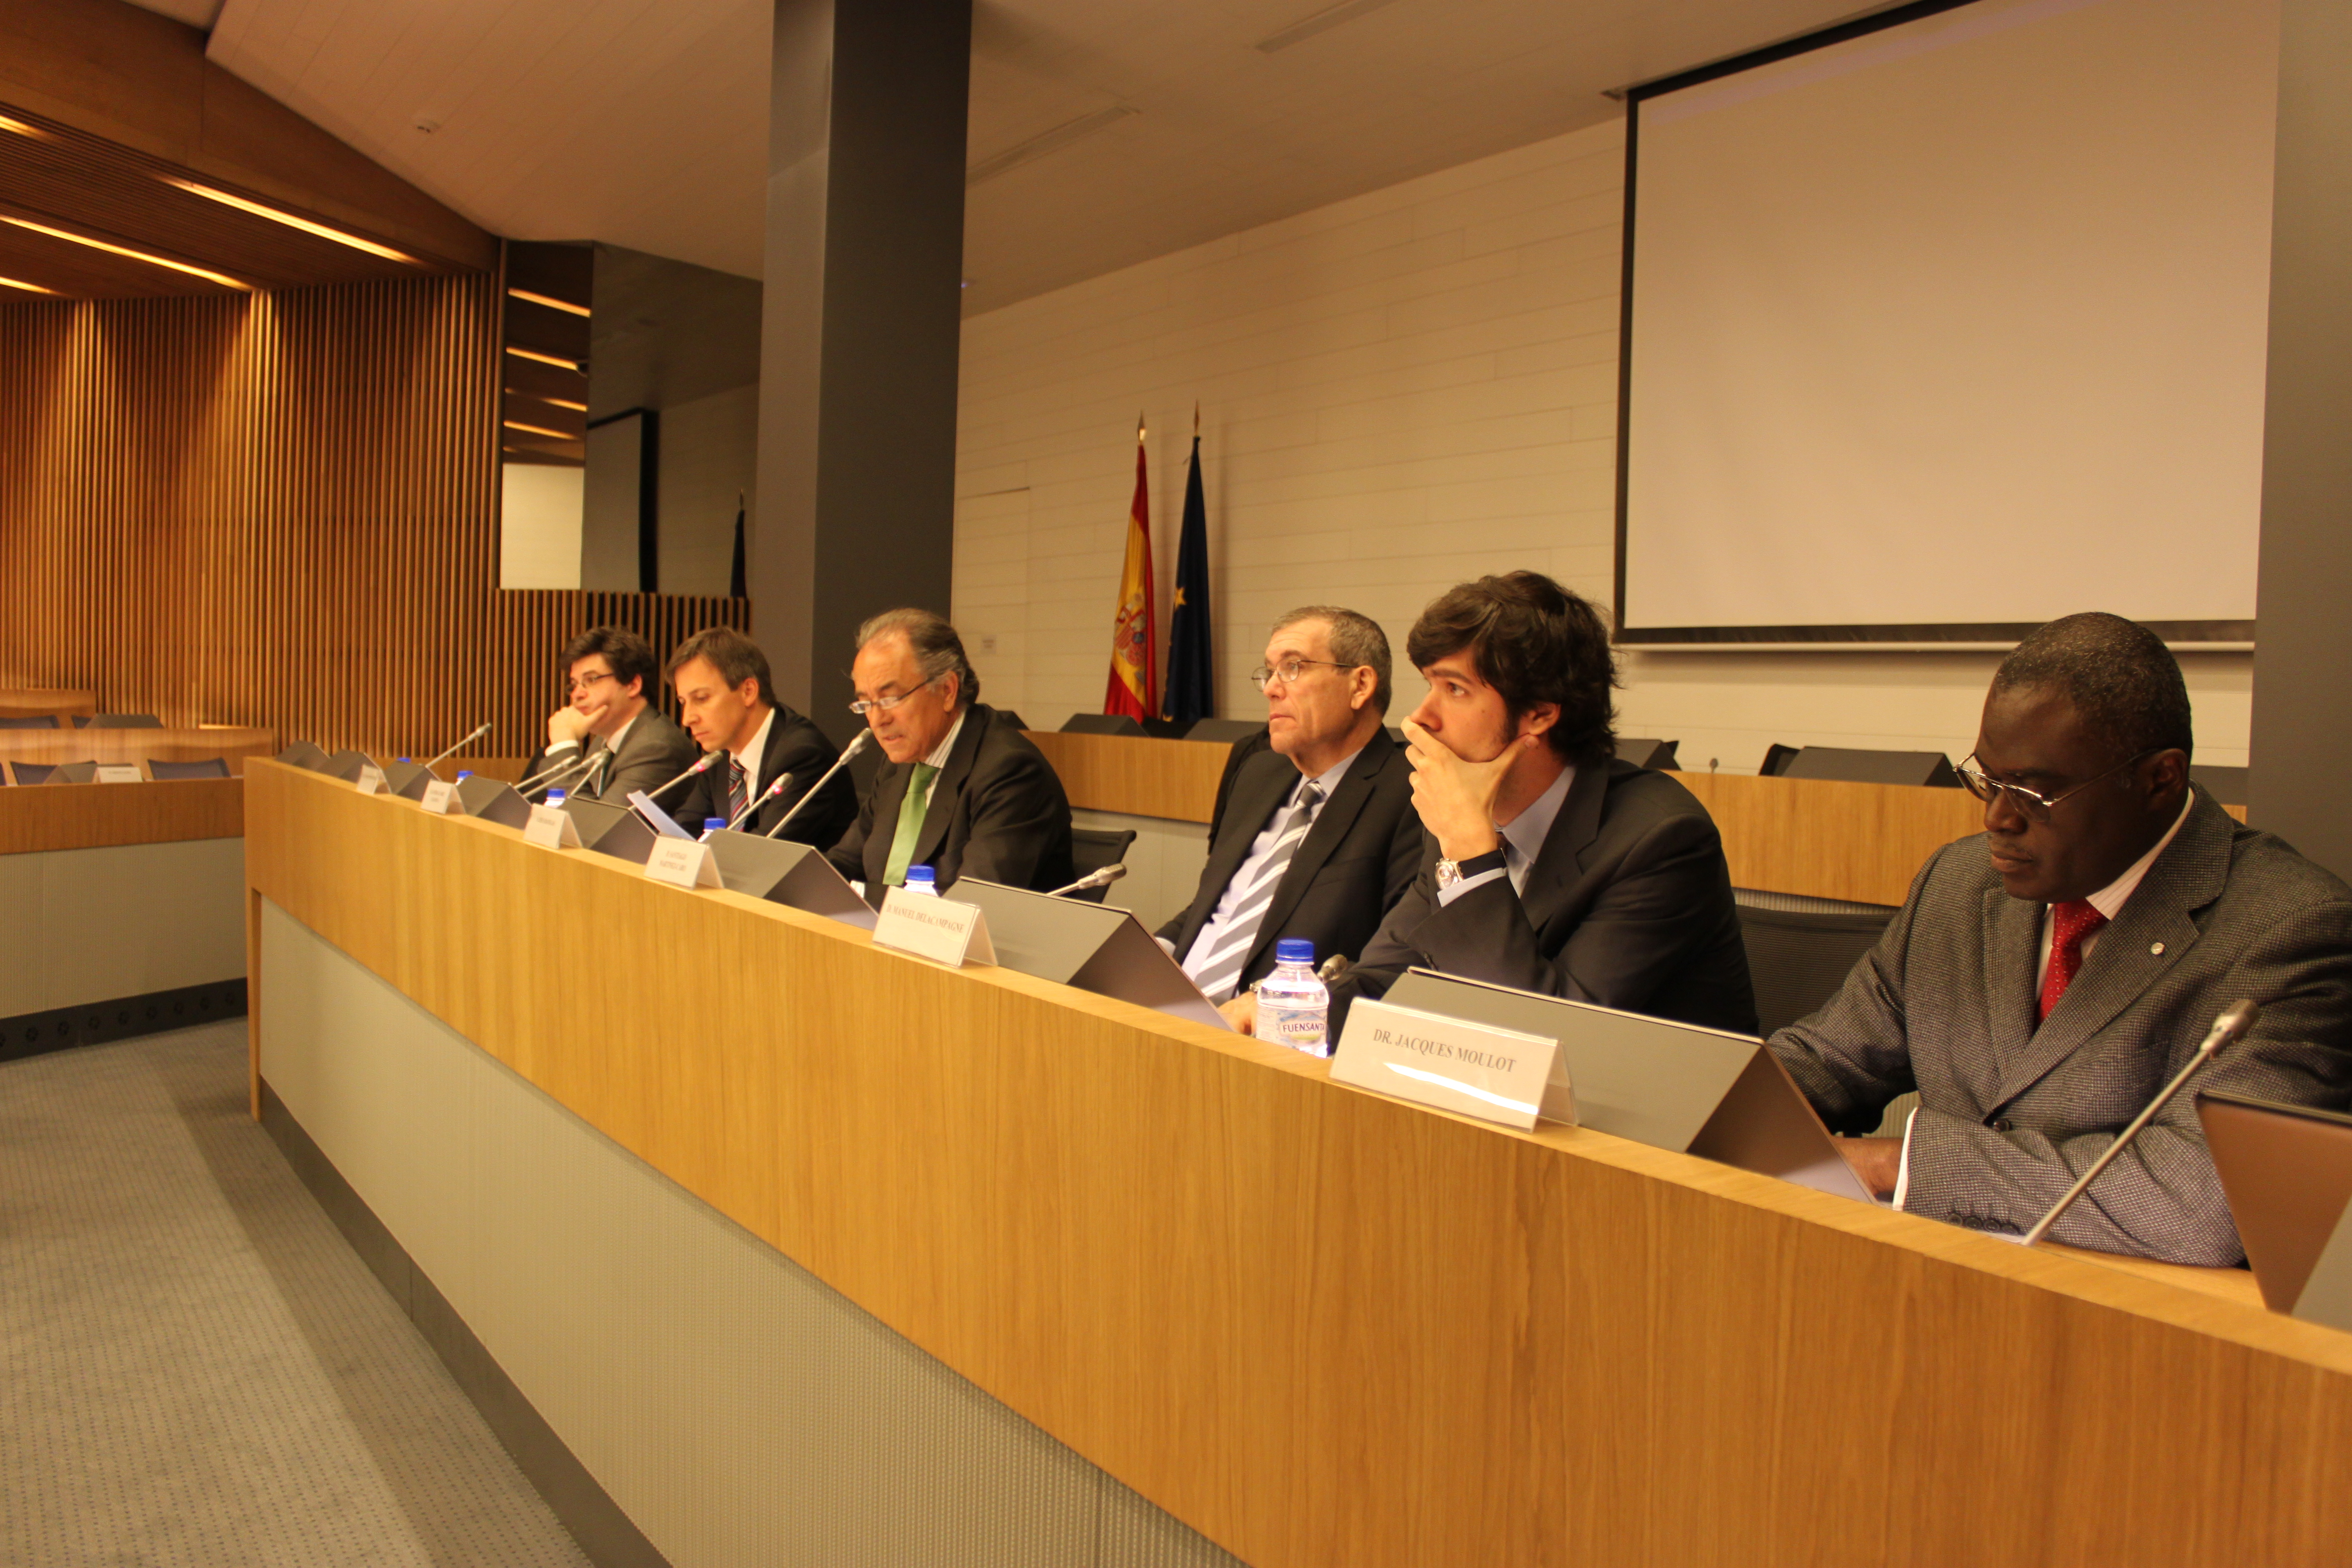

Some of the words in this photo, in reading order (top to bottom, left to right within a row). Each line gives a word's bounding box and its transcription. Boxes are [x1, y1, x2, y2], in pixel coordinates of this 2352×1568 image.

[893, 906, 915, 920] MANUEL
[1373, 1029, 1392, 1045] DR.
[1395, 1034, 1454, 1058] JACQUES
[1455, 1047, 1517, 1073] MOULOT
